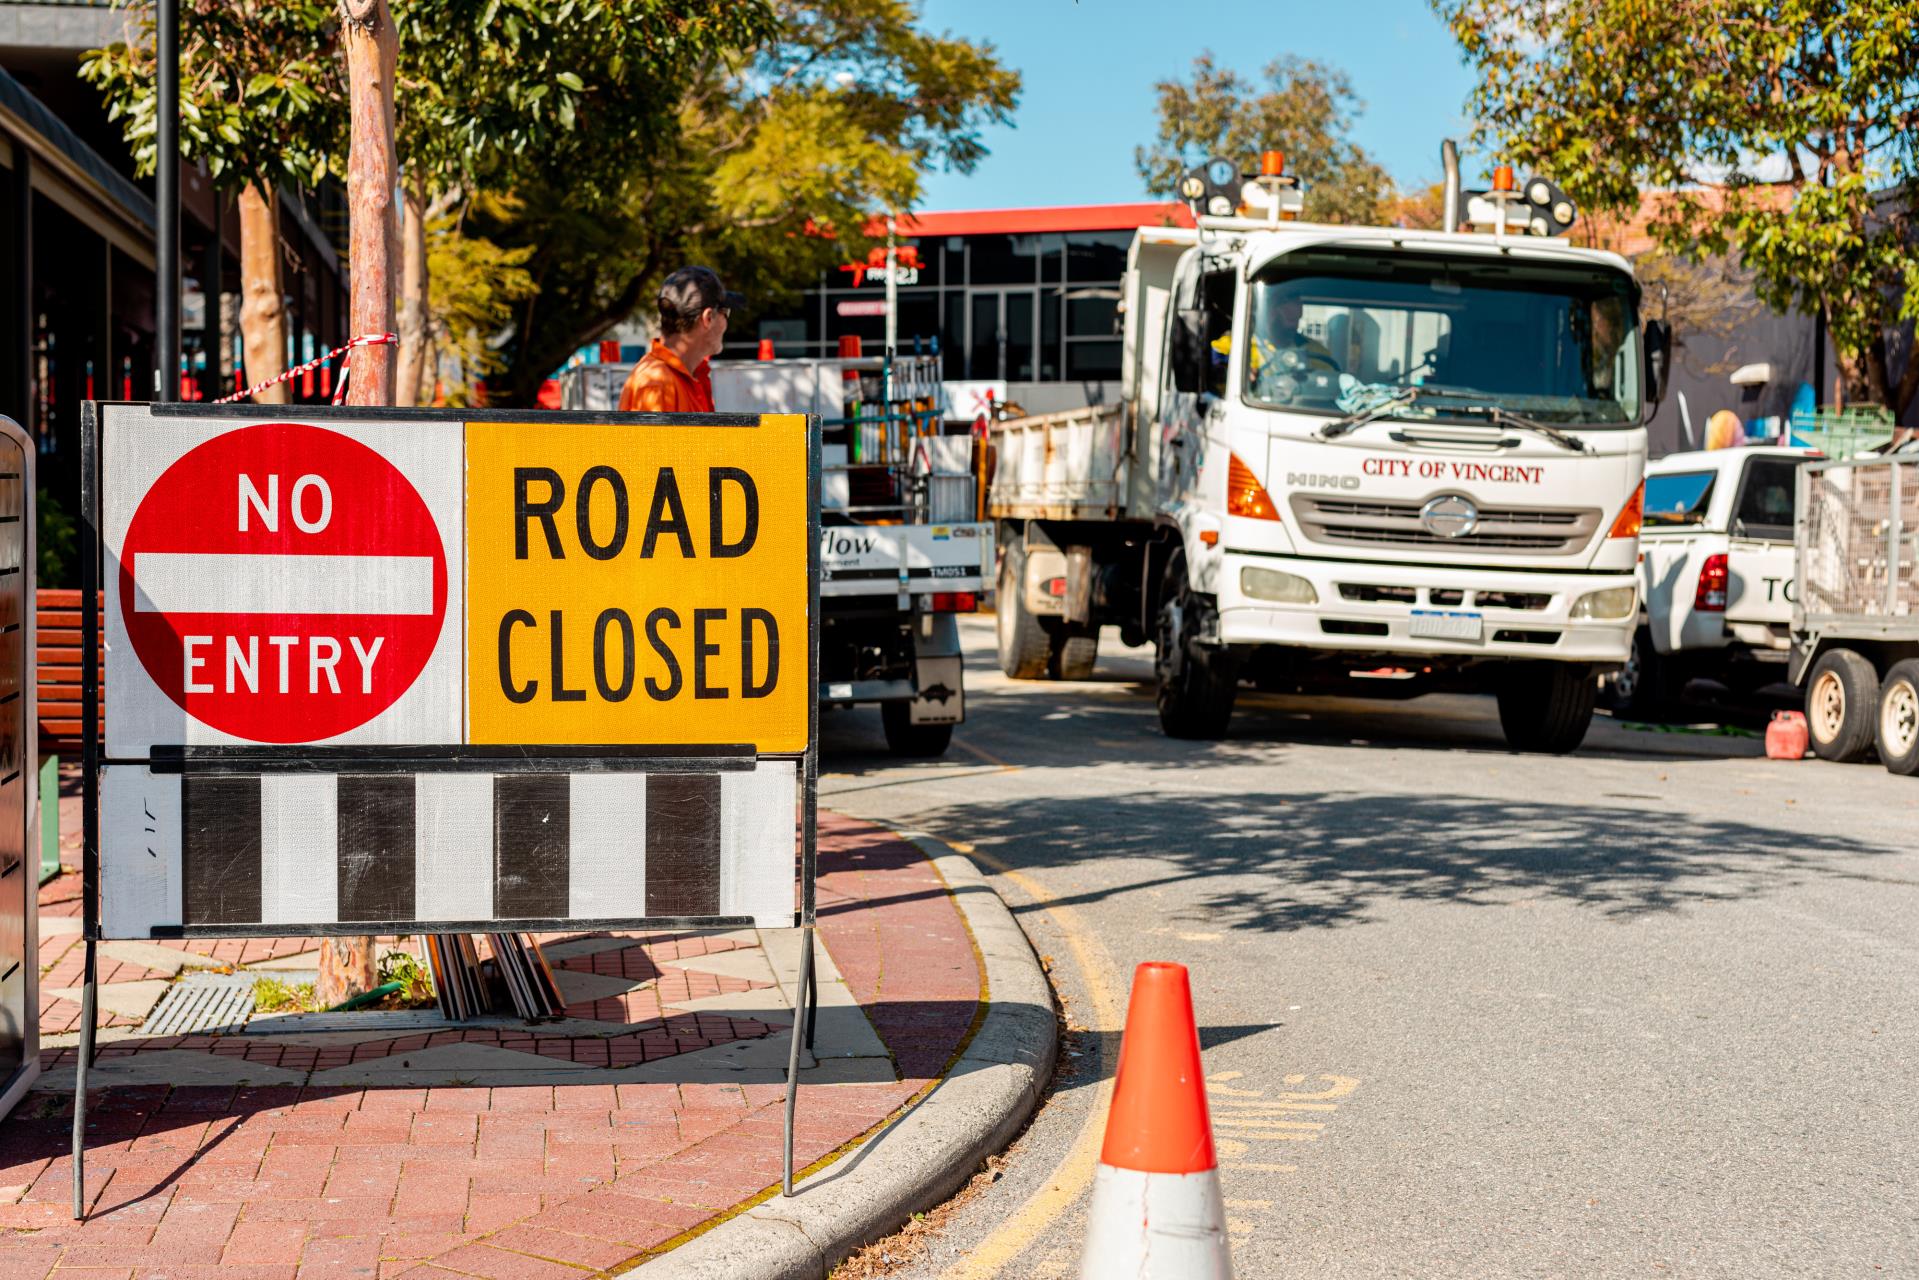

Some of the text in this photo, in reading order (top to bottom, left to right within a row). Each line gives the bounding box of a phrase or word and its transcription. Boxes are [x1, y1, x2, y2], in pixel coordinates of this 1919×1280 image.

[1286, 472, 1361, 490] HINO
[1362, 457, 1544, 485] CITY OF VINCENT
[237, 472, 333, 535] NO
[514, 465, 759, 561] ROAD
[183, 634, 386, 696] ENTRY
[498, 607, 780, 704] CLOSED
